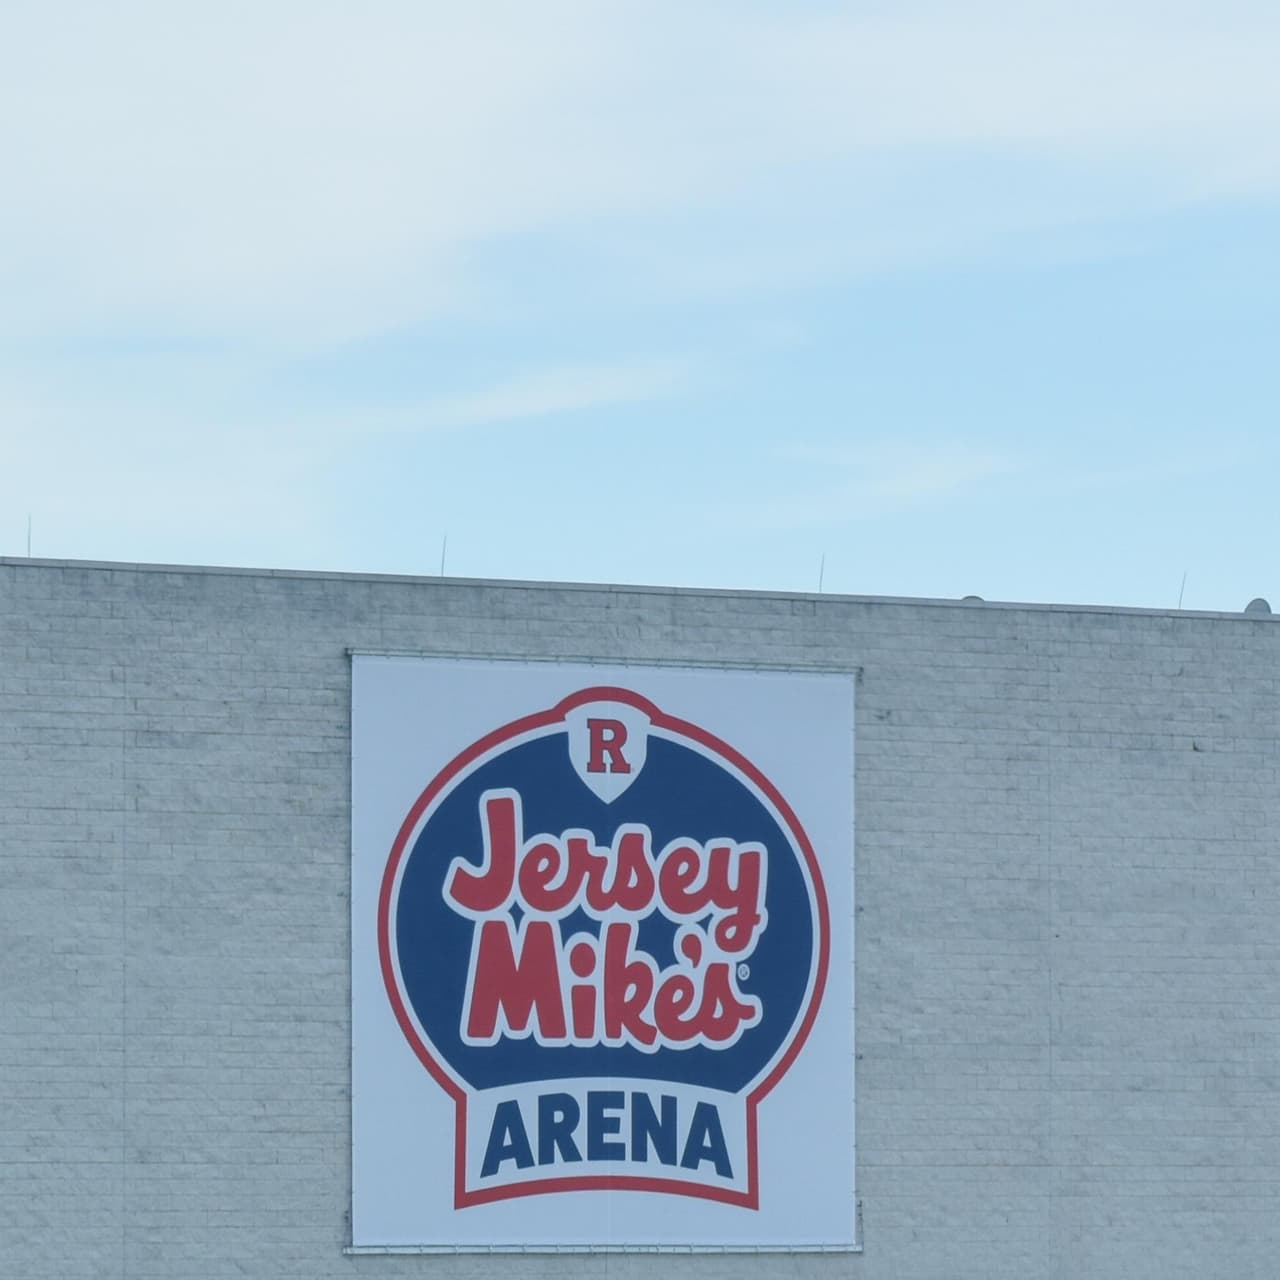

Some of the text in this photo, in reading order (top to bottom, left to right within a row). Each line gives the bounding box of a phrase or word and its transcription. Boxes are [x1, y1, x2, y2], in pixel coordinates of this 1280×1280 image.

[587, 718, 631, 774] R
[448, 795, 762, 953] Jersey
[466, 918, 757, 1046] Mike's
[479, 1090, 735, 1179] ARENA
